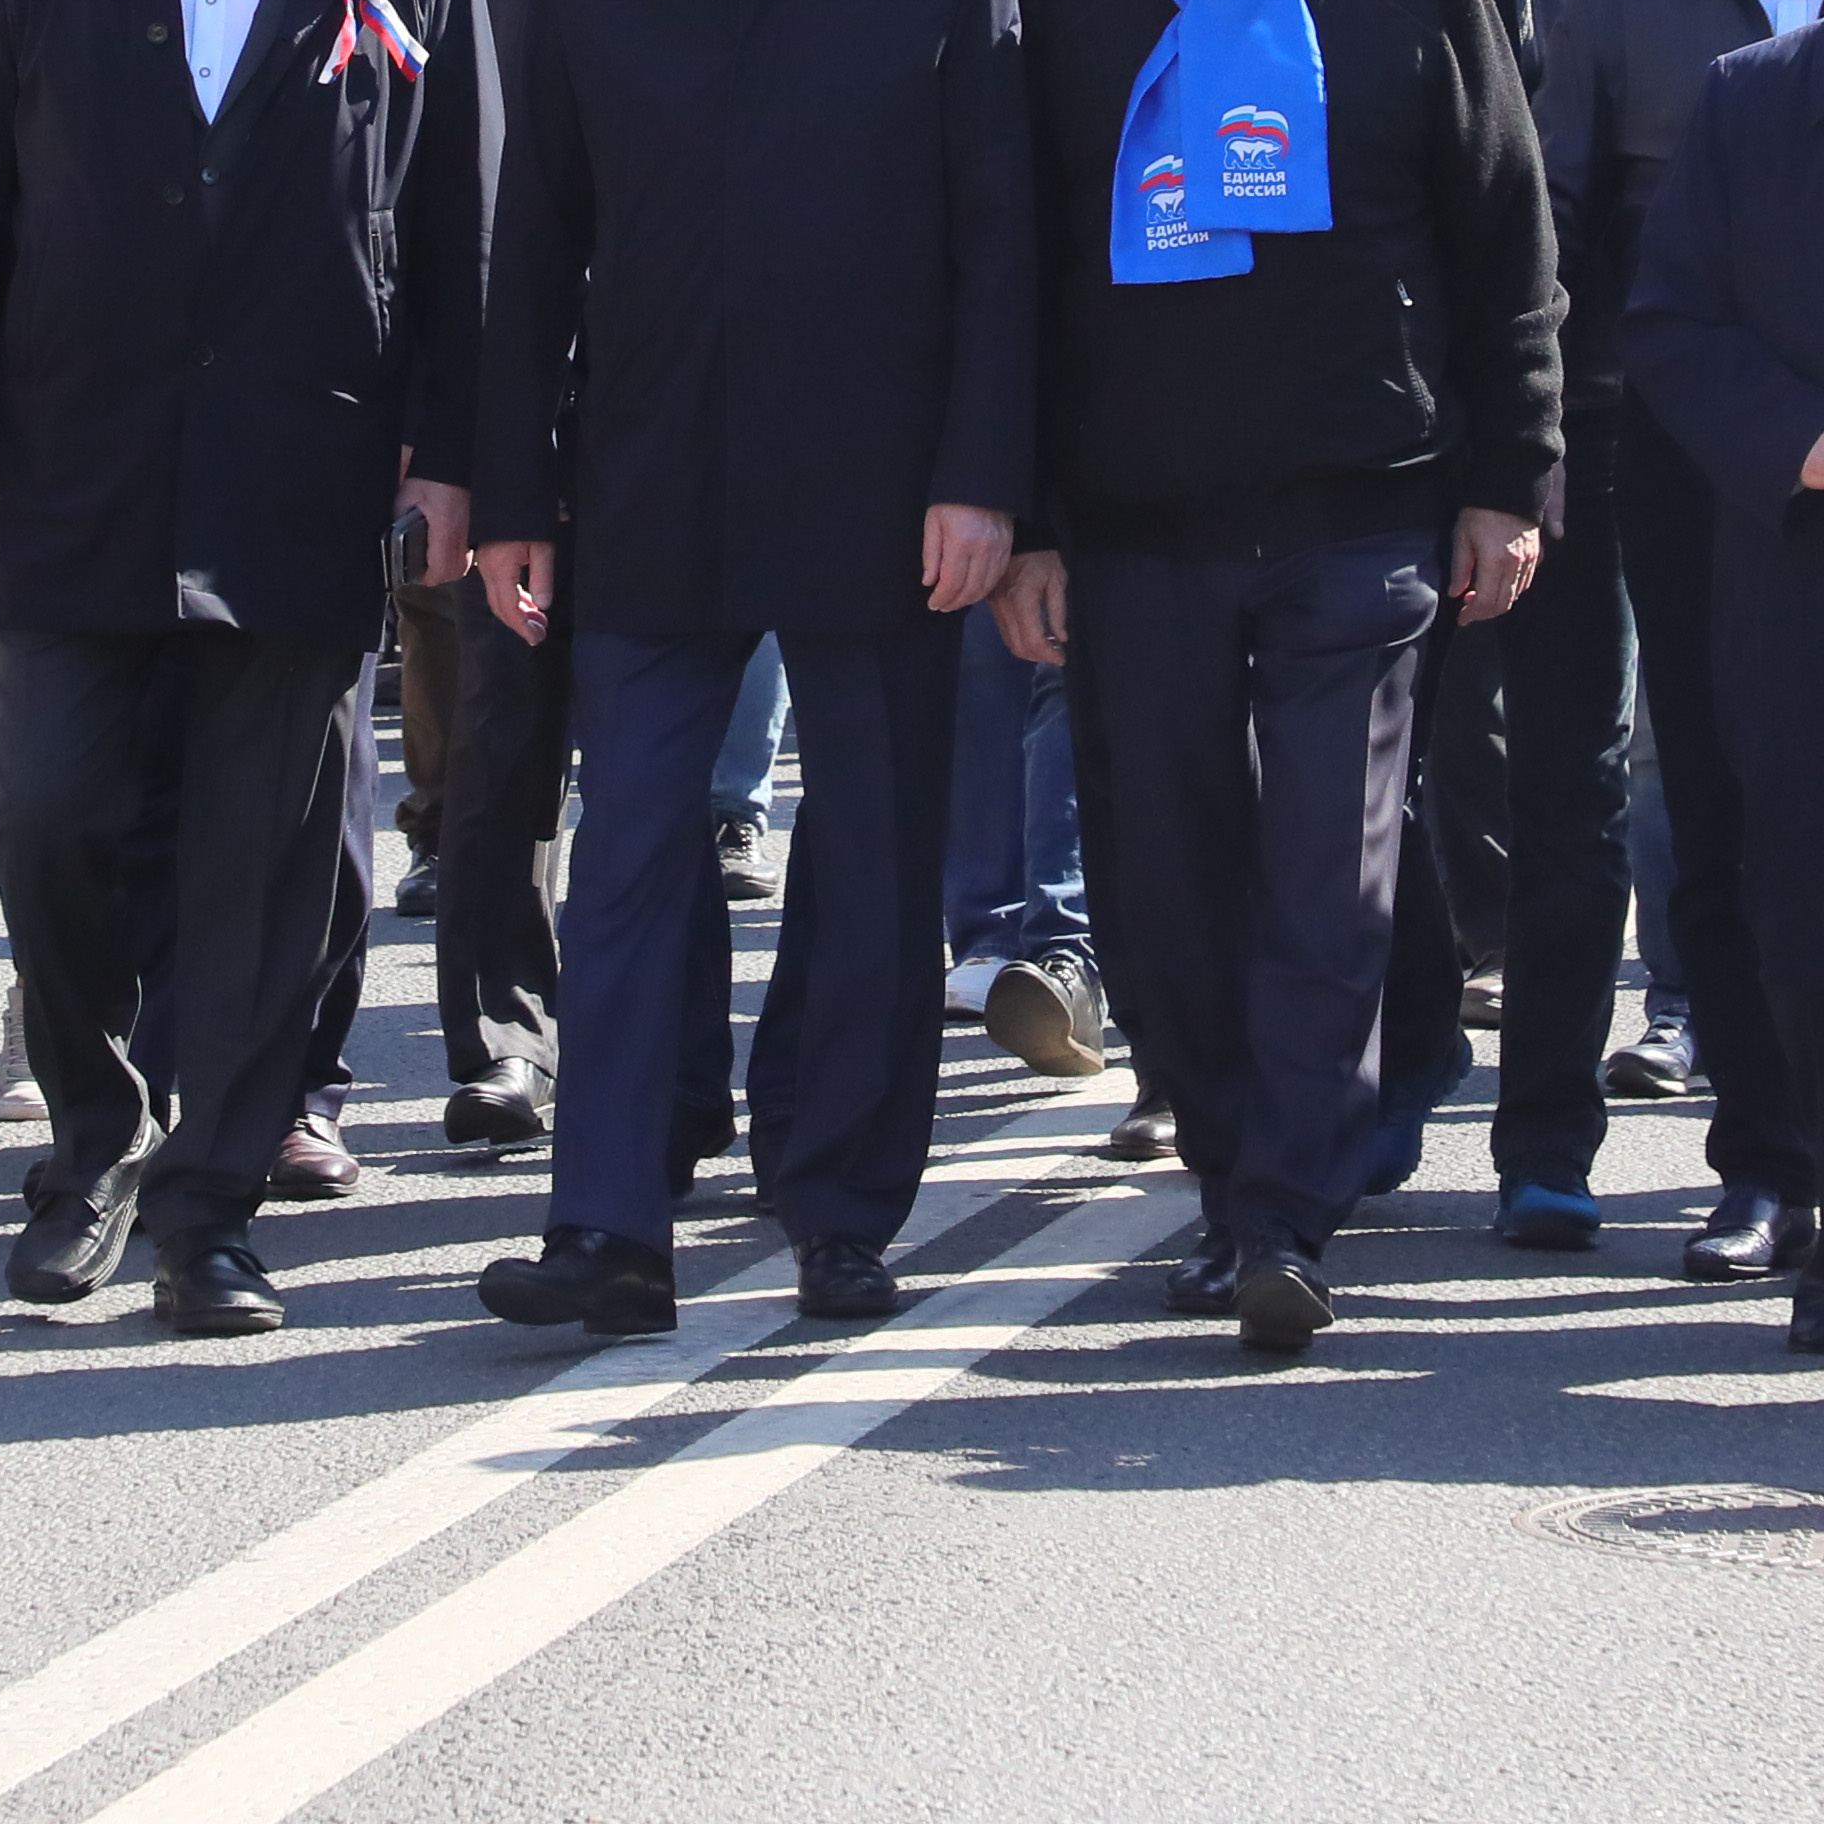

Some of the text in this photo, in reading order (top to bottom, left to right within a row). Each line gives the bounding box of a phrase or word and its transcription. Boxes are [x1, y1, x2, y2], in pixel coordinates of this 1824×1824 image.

[1222, 171, 1286, 184] ЕДИНАЯ
[1223, 184, 1287, 197] РОССИЯ
[1147, 231, 1210, 251] РОССИЯ
